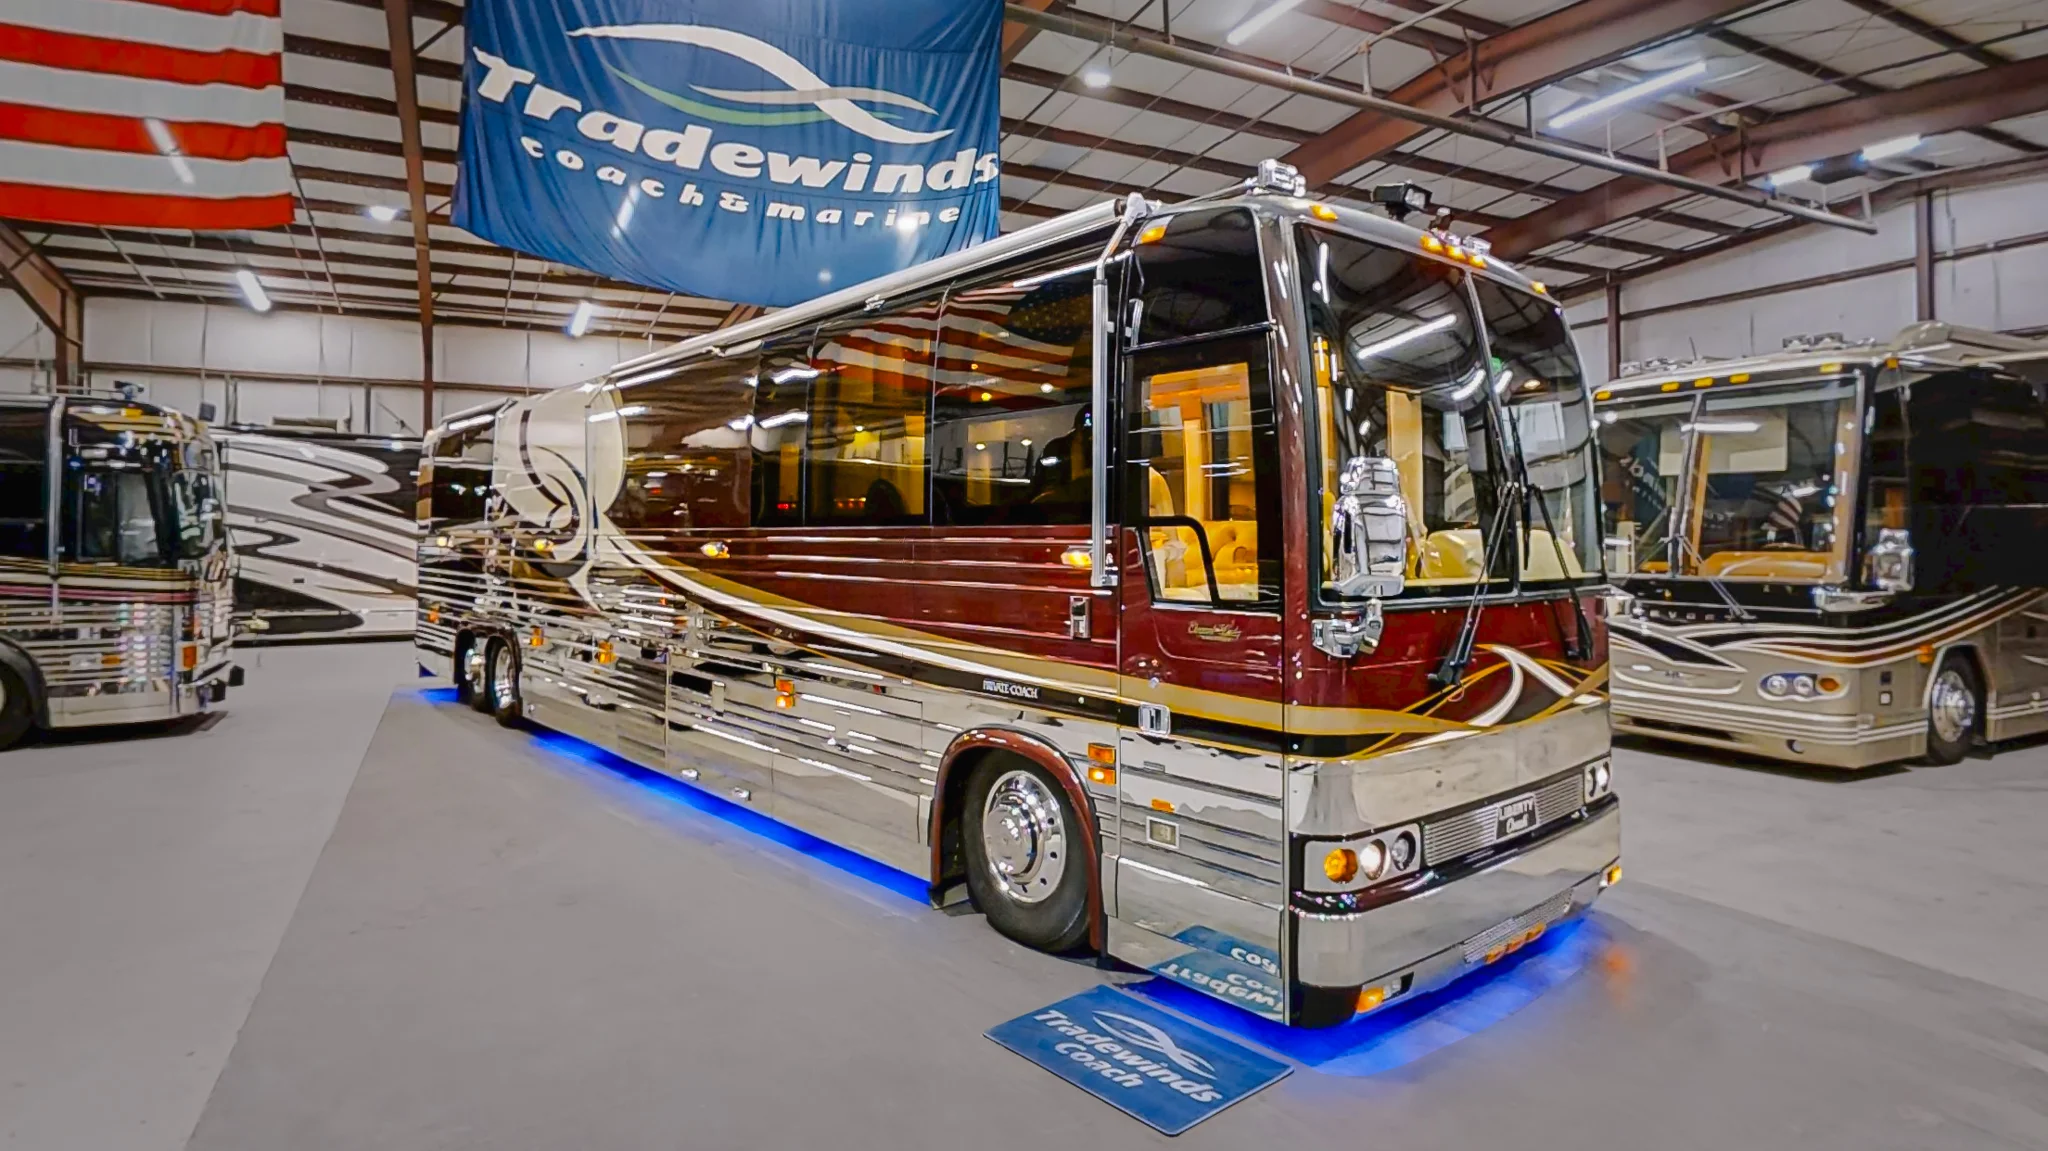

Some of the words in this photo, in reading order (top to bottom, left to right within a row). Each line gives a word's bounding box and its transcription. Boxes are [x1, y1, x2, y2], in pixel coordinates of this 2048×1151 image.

[473, 47, 999, 194] Tradewinds
[521, 136, 704, 206] coach
[719, 193, 749, 213] &
[767, 201, 960, 226] marine
[1033, 1009, 1223, 1103] Tradewinds
[1054, 1042, 1144, 1088] Coach
